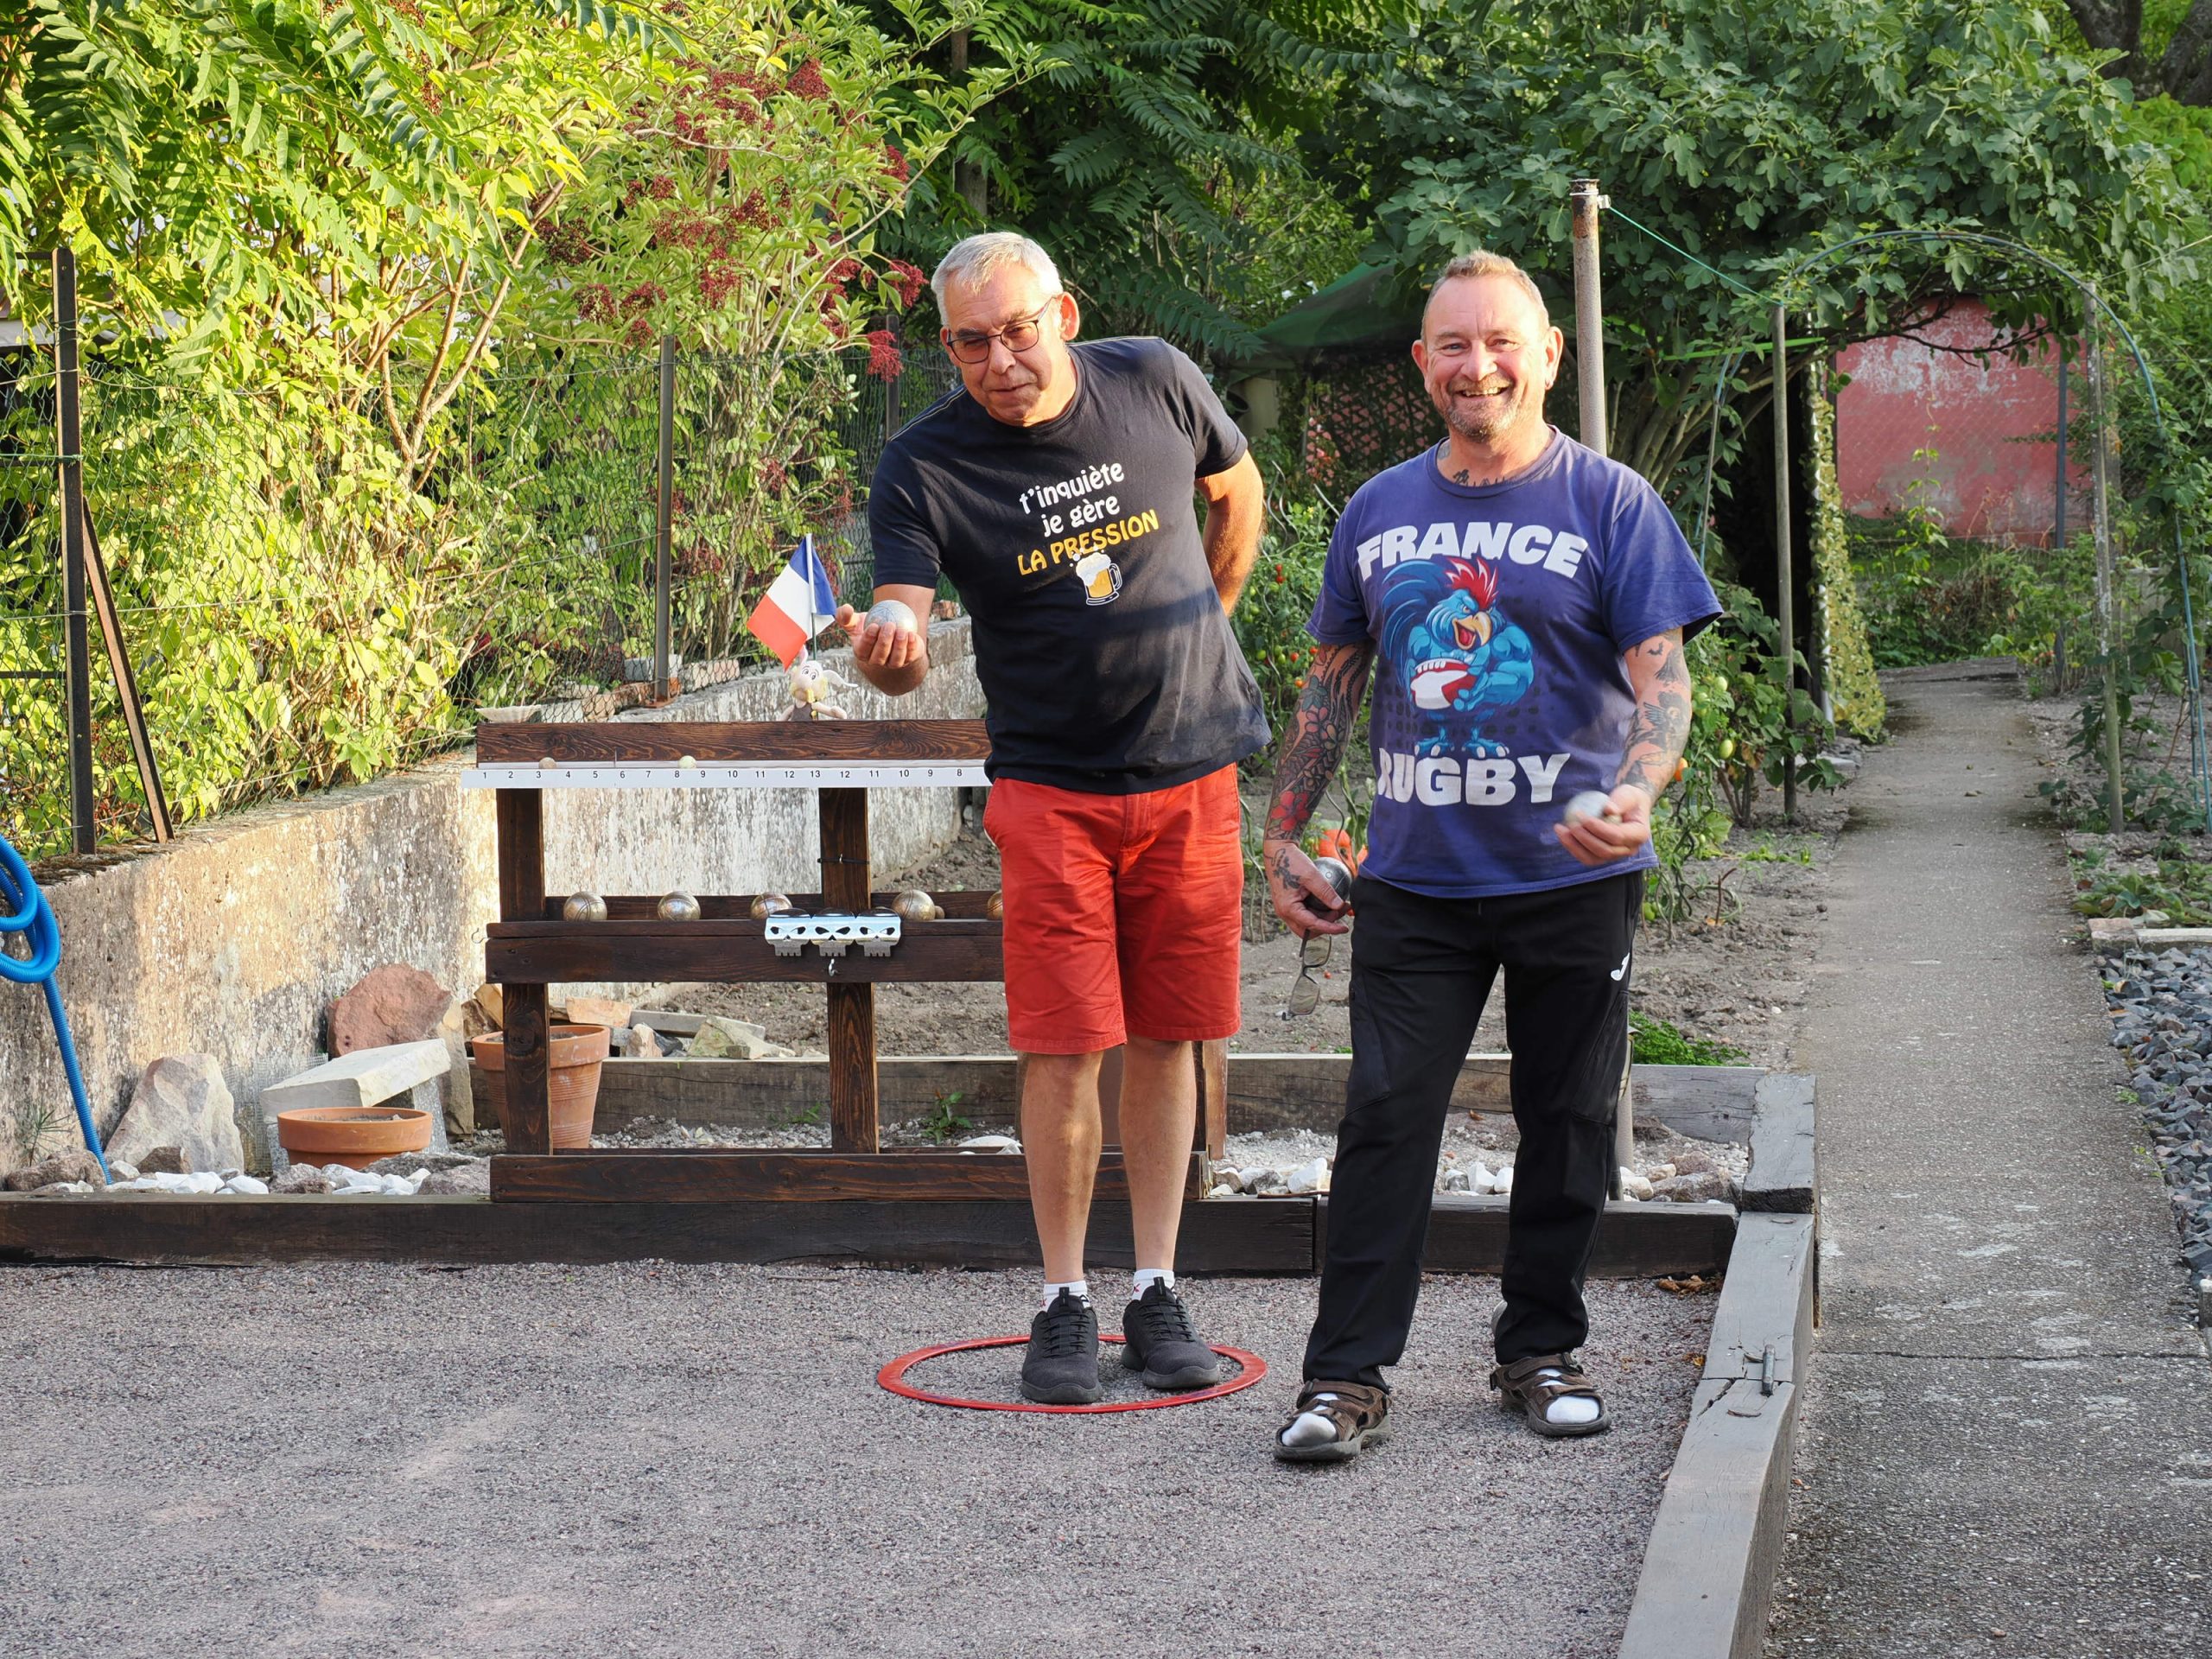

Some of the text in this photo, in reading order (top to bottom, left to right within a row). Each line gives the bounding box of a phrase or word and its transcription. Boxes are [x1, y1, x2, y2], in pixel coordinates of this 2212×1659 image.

[1041, 495, 1121, 537] je gère
[1017, 509, 1160, 575] LA PRESSION
[1357, 521, 1589, 582] FRANCE
[728, 770, 738, 779] 10
[785, 770, 795, 779] 12
[810, 769, 821, 778] 13
[840, 770, 851, 779] 12
[899, 769, 910, 778] 10
